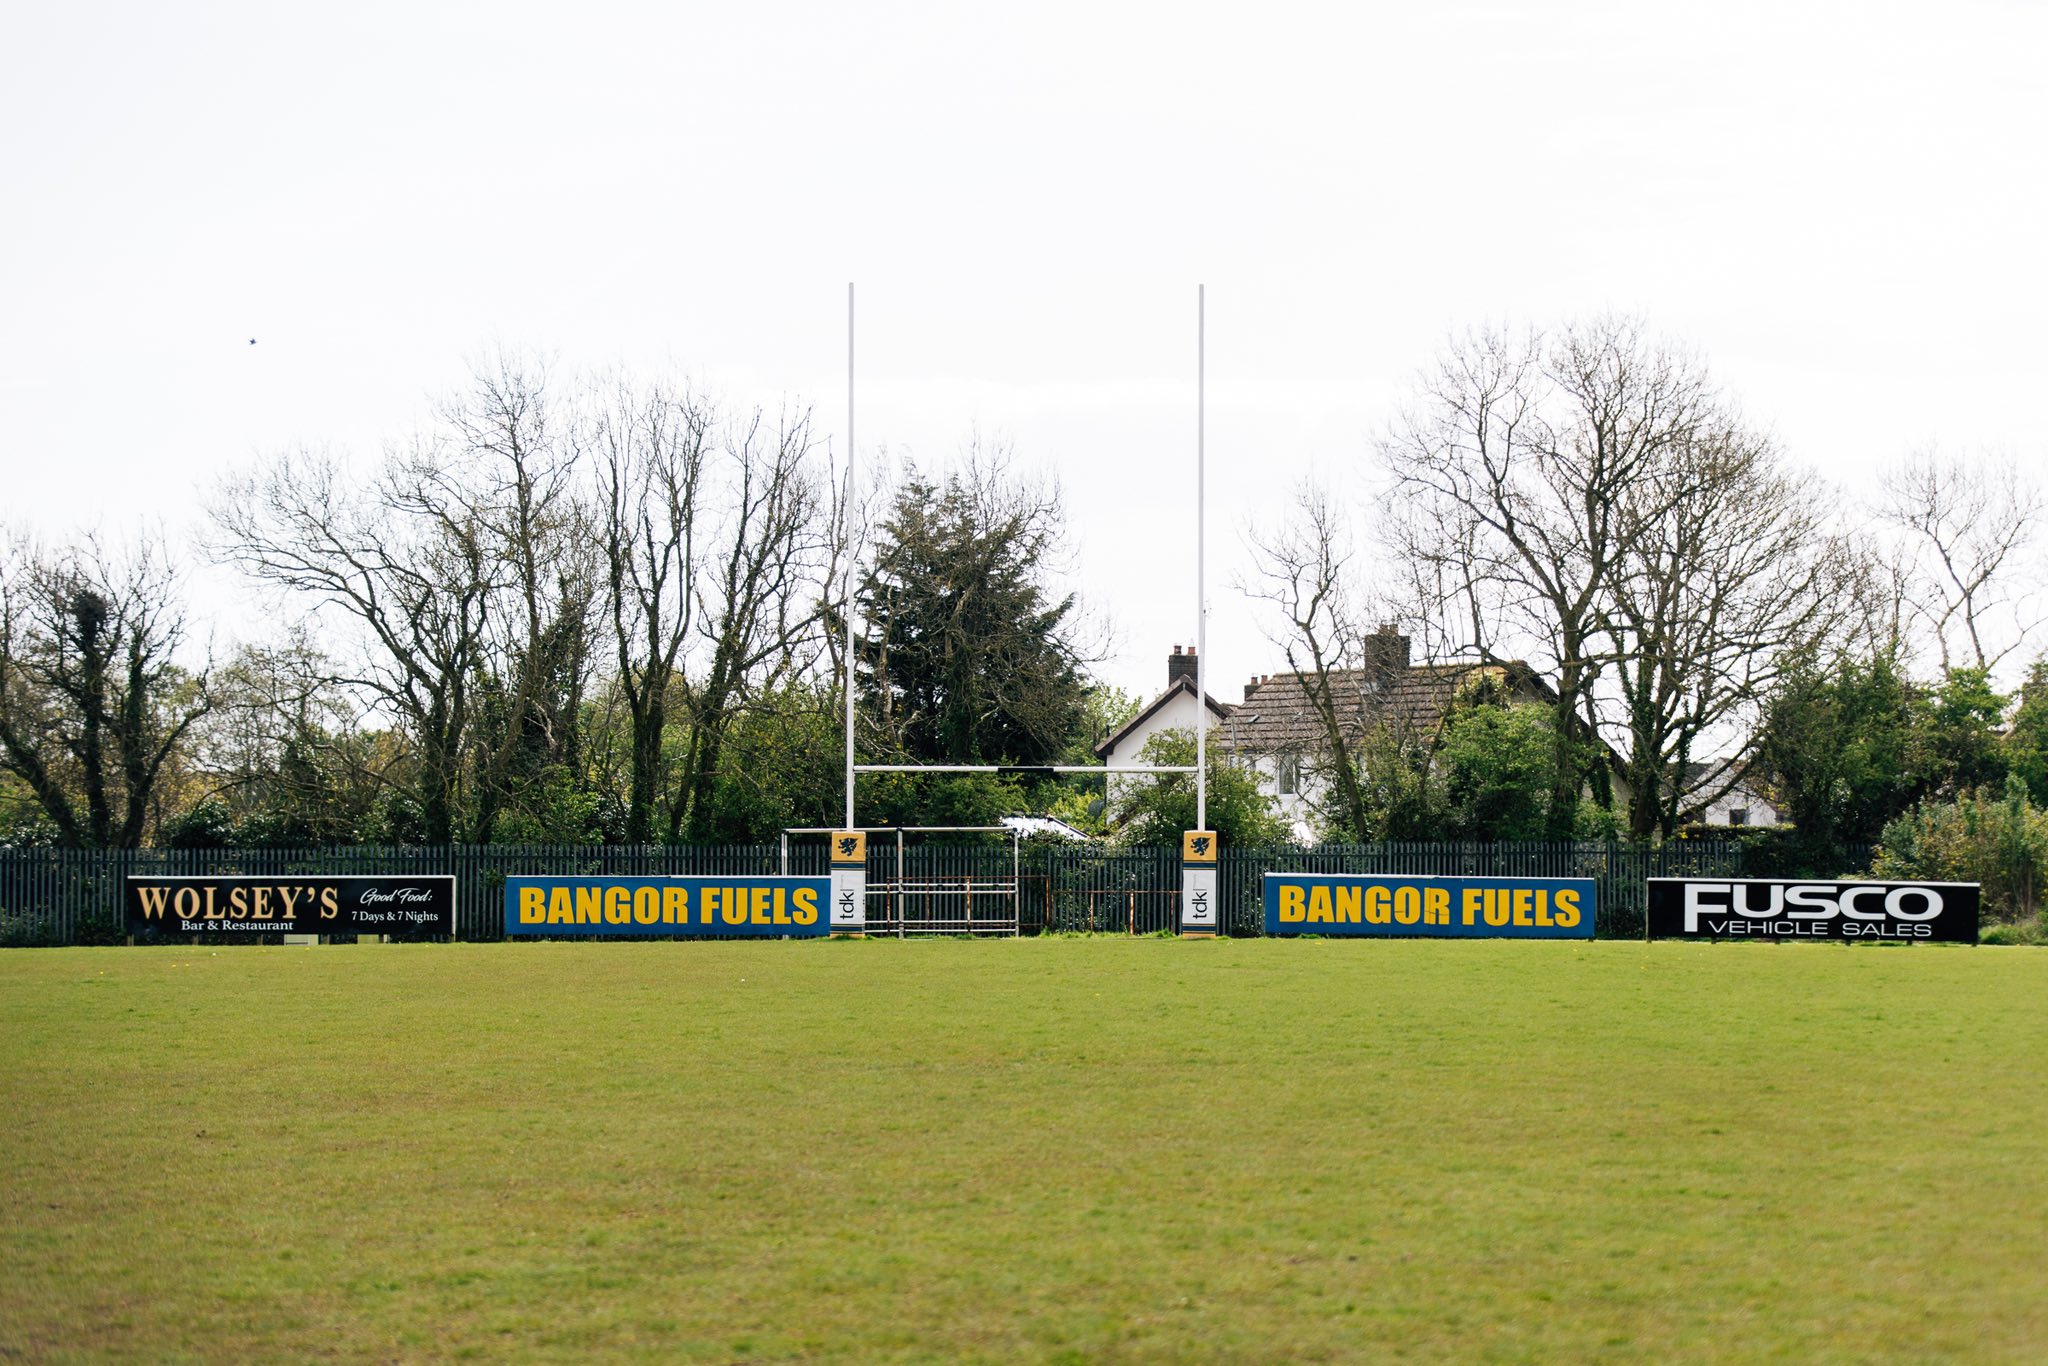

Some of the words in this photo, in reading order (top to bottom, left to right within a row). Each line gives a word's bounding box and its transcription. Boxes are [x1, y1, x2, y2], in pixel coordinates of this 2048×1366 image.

[136, 886, 339, 920] WOLSEY'S
[359, 887, 397, 906] Good
[397, 887, 433, 905] Food:
[519, 886, 689, 925] BANGOR
[700, 887, 819, 926] FUELS
[1279, 885, 1451, 926] BANGOR
[1462, 888, 1581, 928] FUELS
[1684, 883, 1944, 933] FUSCO
[181, 920, 205, 931] Bar
[207, 920, 219, 931] &
[222, 920, 294, 931] Restaurant
[352, 911, 358, 921] 7
[359, 911, 385, 924] Days
[386, 911, 396, 921] &
[398, 911, 404, 921] 7
[405, 911, 439, 924] Nights
[1708, 920, 1828, 936] VEHICLE
[1842, 922, 1932, 937] SALES
